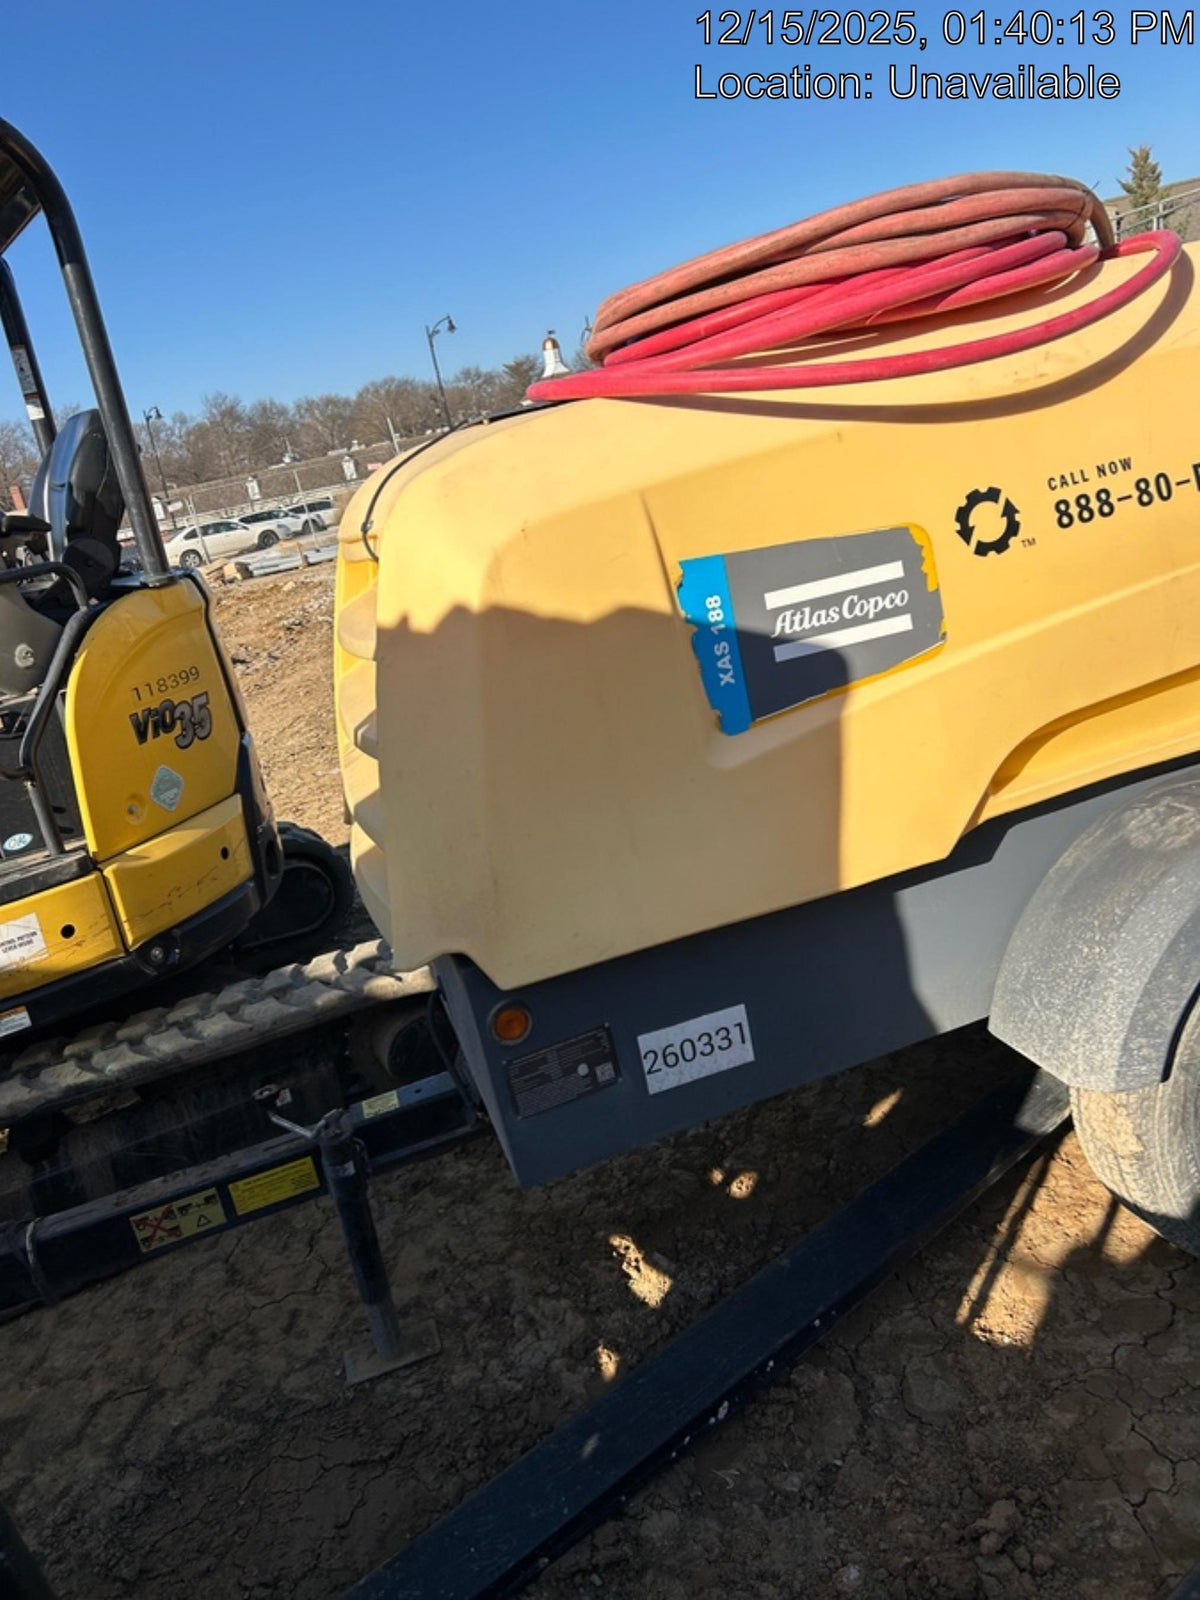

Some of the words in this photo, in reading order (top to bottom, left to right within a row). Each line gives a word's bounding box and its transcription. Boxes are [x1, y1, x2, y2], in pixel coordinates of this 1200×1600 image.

[1047, 469, 1090, 491] CALL
[1096, 457, 1133, 478] NOW
[705, 594, 726, 635] 188
[771, 606, 840, 639] Atlas
[842, 589, 909, 620] Copco
[132, 665, 200, 701] 118399
[714, 641, 735, 687] XAS
[642, 1021, 747, 1075] 260331
